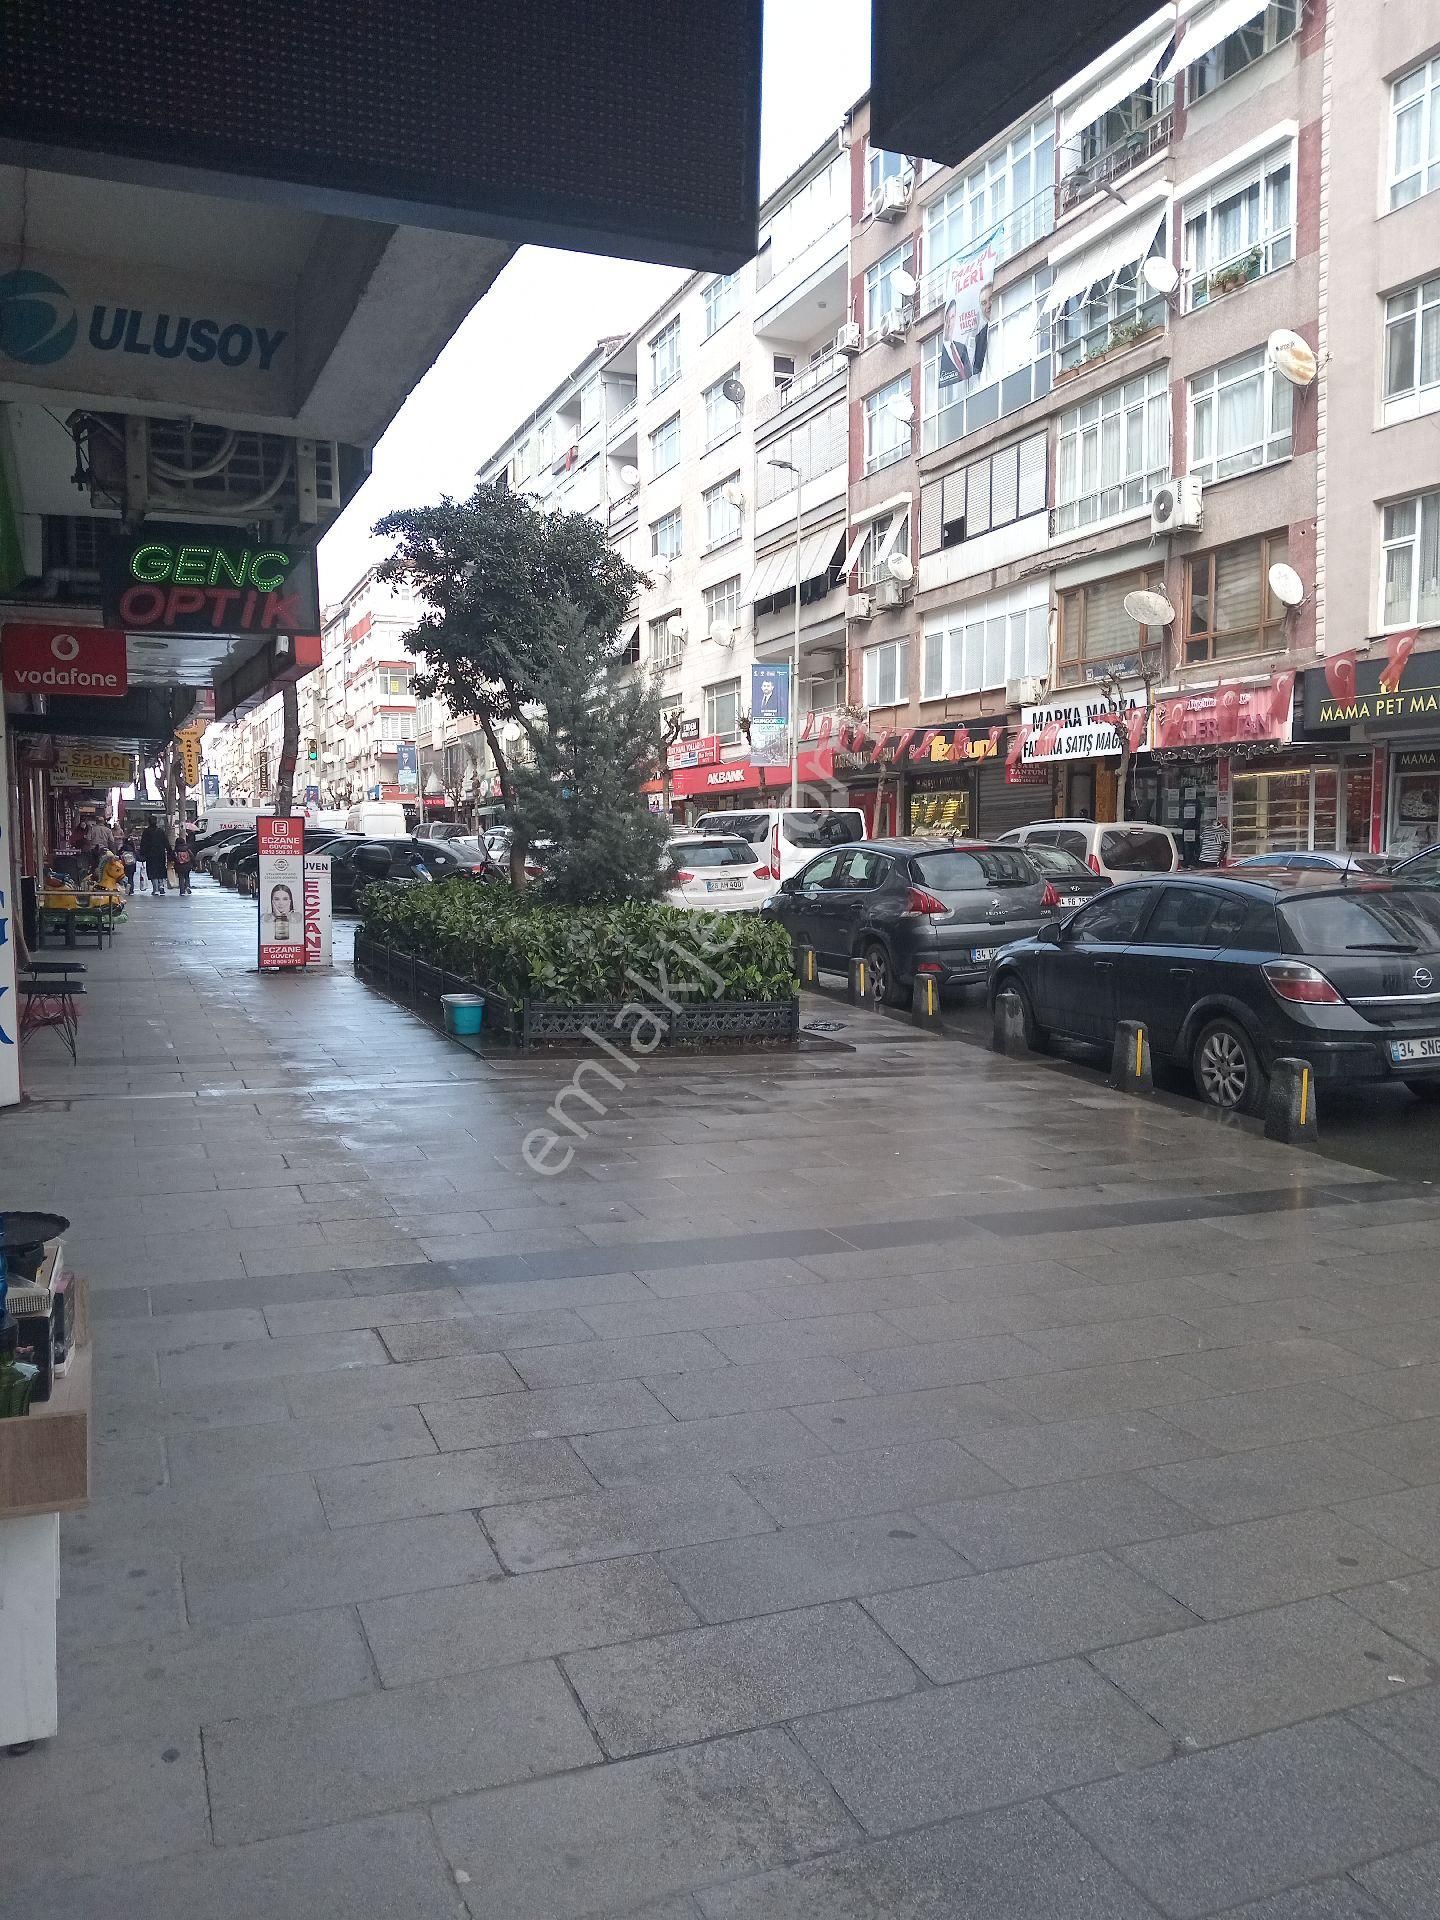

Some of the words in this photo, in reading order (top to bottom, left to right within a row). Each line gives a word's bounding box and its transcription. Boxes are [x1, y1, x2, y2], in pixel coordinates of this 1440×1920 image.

[89, 304, 289, 371] ULUSOY
[130, 543, 290, 592] GENÇ
[14, 666, 118, 687] vodafone
[1032, 707, 1083, 733] MARKA
[1319, 701, 1371, 722] MAMA
[1376, 697, 1405, 717] PET
[1065, 734, 1094, 757] SATIŞ
[1401, 753, 1436, 764] MAMA
[707, 770, 745, 785] AKBANK
[261, 836, 300, 844] ECZANE
[304, 881, 321, 963] ECZANE
[263, 945, 301, 954] ECZANE
[976, 950, 986, 960] 34
[1399, 1041, 1415, 1057] 34
